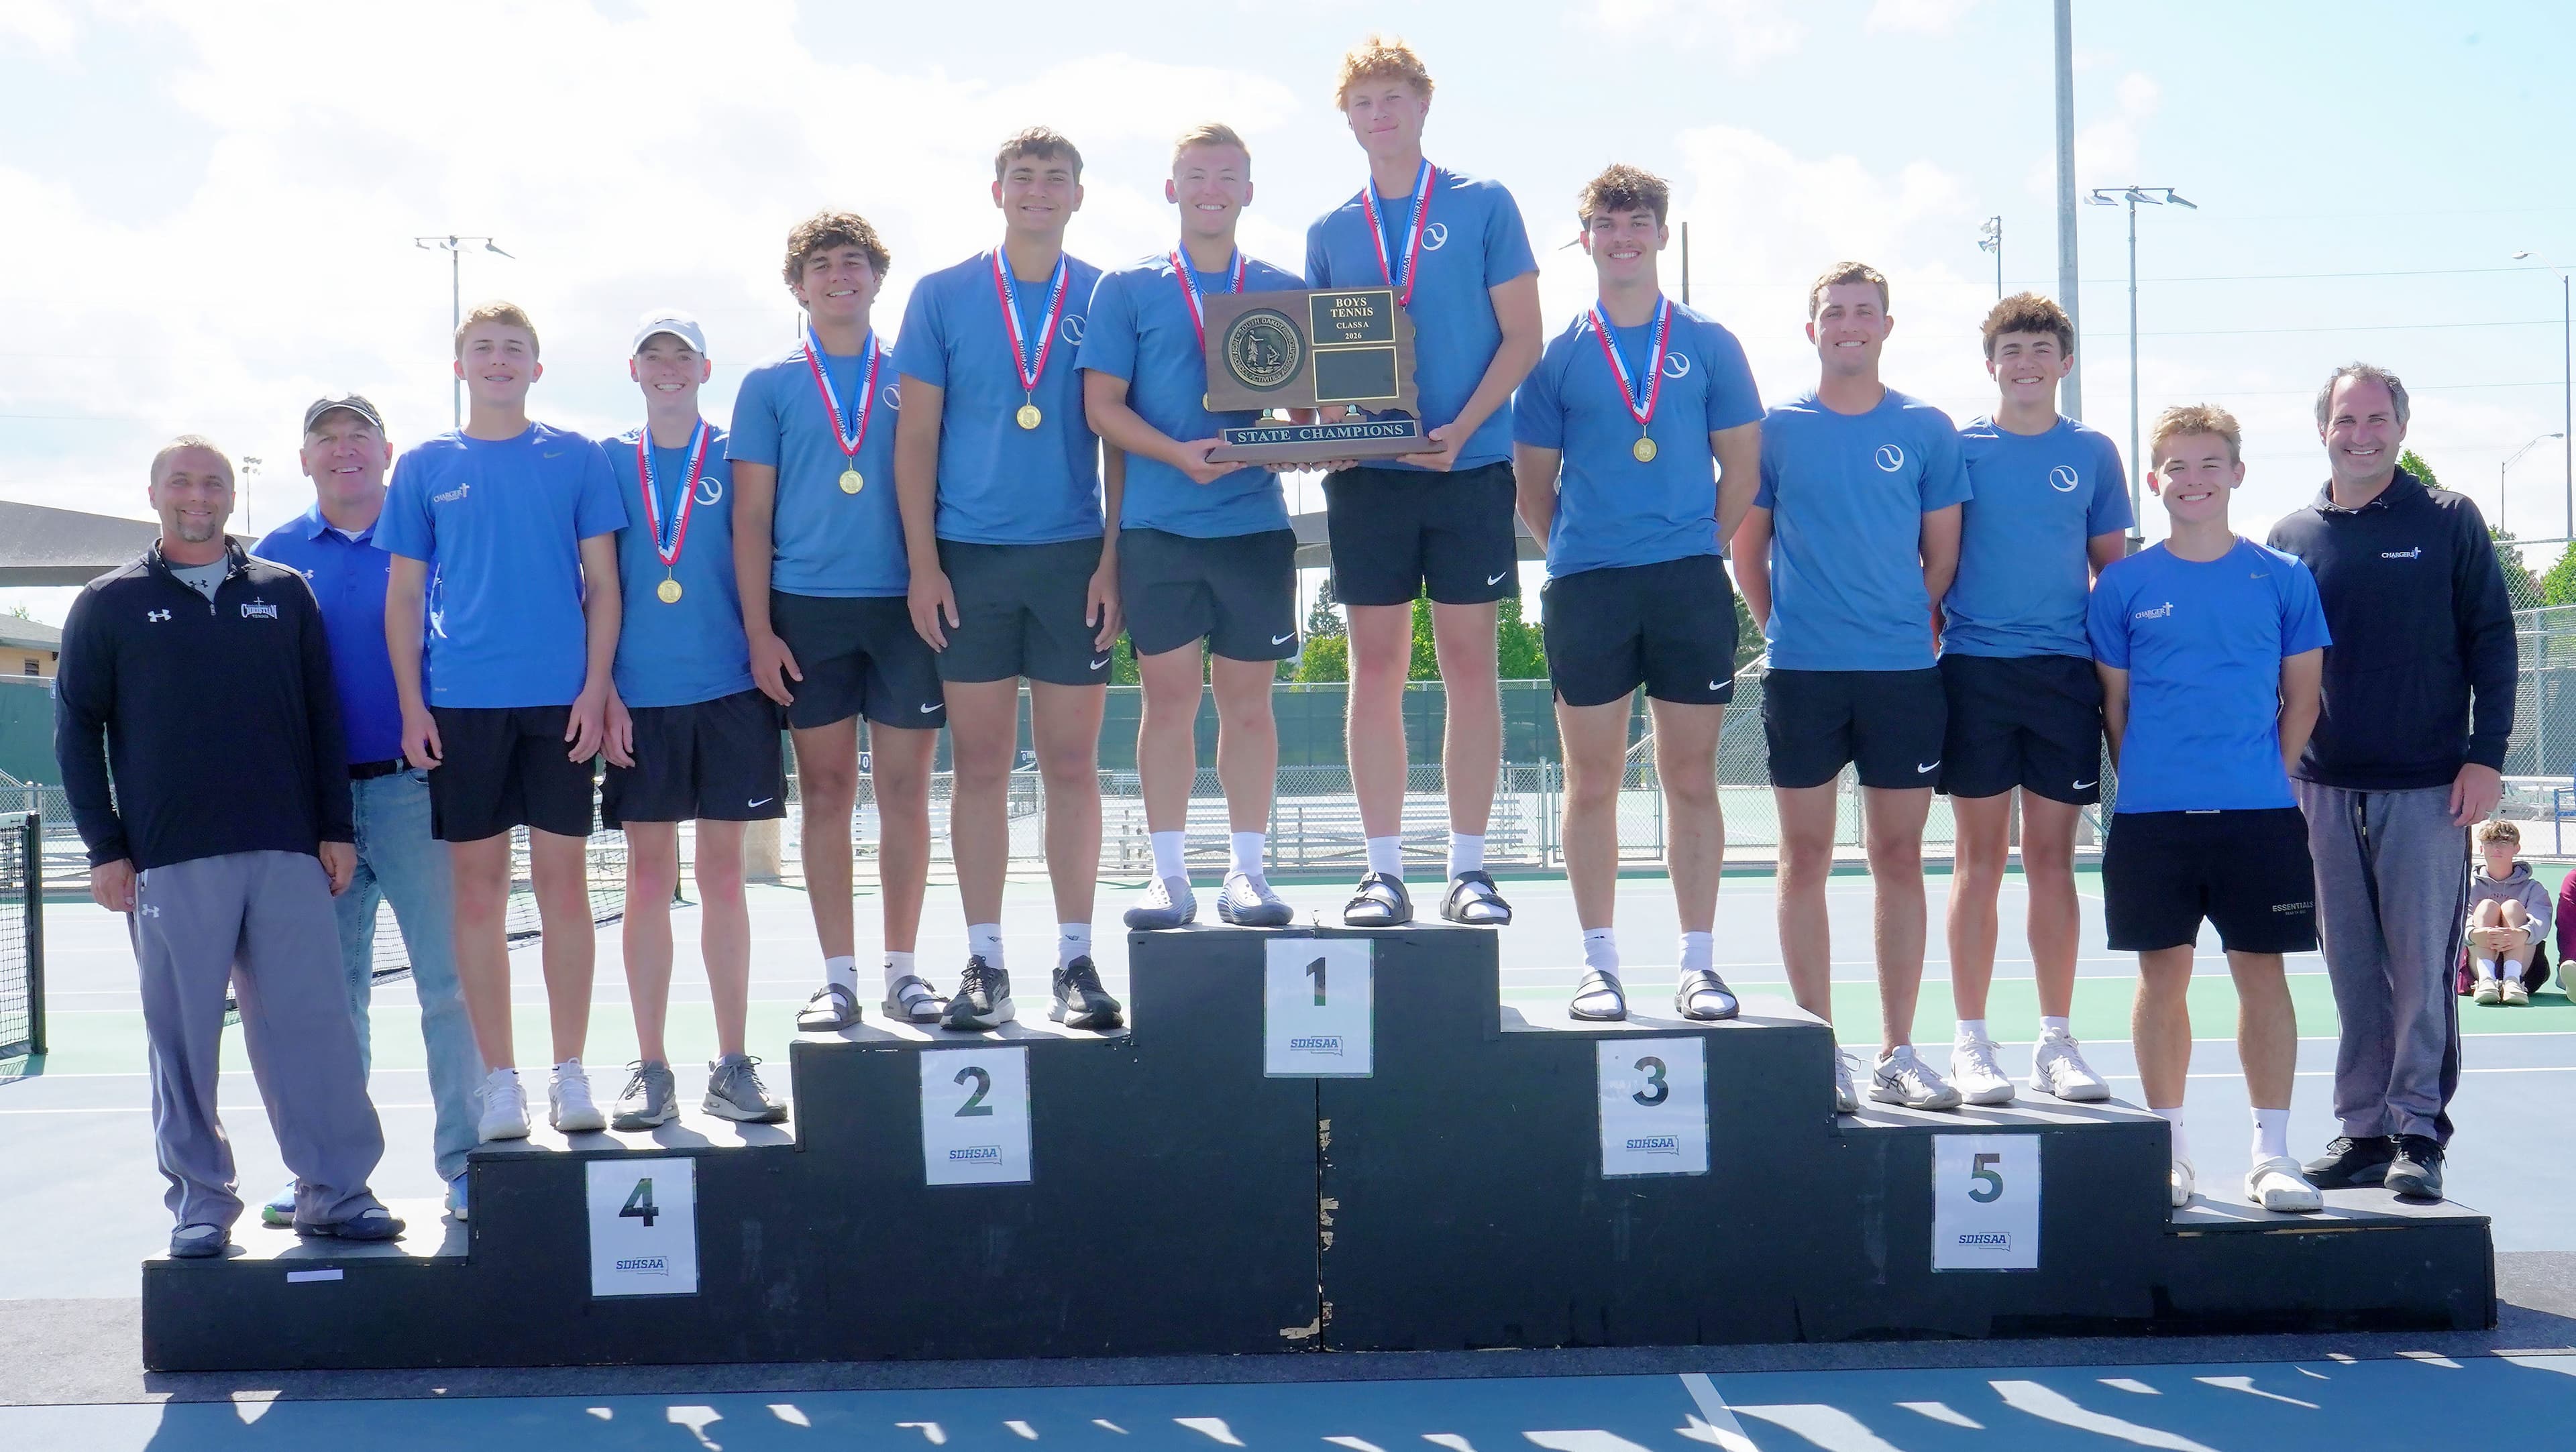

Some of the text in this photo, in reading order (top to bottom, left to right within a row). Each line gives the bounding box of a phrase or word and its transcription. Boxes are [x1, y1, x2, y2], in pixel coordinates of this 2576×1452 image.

[1412, 197, 1424, 227] SDHSAA
[1000, 272, 1012, 301] SDHSAA
[1048, 288, 1061, 315] SDHSAA
[1336, 297, 1367, 308] BOYS
[1330, 306, 1374, 318] TENNIS
[1239, 318, 1287, 333] SOUTH DAKOTA
[1599, 321, 1613, 346] SDHSAA
[1655, 321, 1665, 346] SDHSAA
[1645, 374, 1655, 403] SDHSAA
[1237, 425, 1404, 443] STATE CHAMPIONS
[241, 604, 278, 619] CHRISTIAN
[2135, 608, 2165, 619] CHARGER
[2272, 901, 2314, 912] ESSENTIALS
[1306, 957, 1326, 1006] 1
[1291, 1039, 1338, 1048] SDHSAA
[1633, 1056, 1668, 1107] 3
[954, 1066, 993, 1117] 2
[1626, 1138, 1674, 1149] SDHSAA
[949, 1148, 998, 1160] SDHSAA
[1968, 1154, 2003, 1203] 5
[619, 1178, 659, 1227] 4
[1959, 1235, 2006, 1243] SDHSAA
[616, 1259, 664, 1270] SDHSAA
